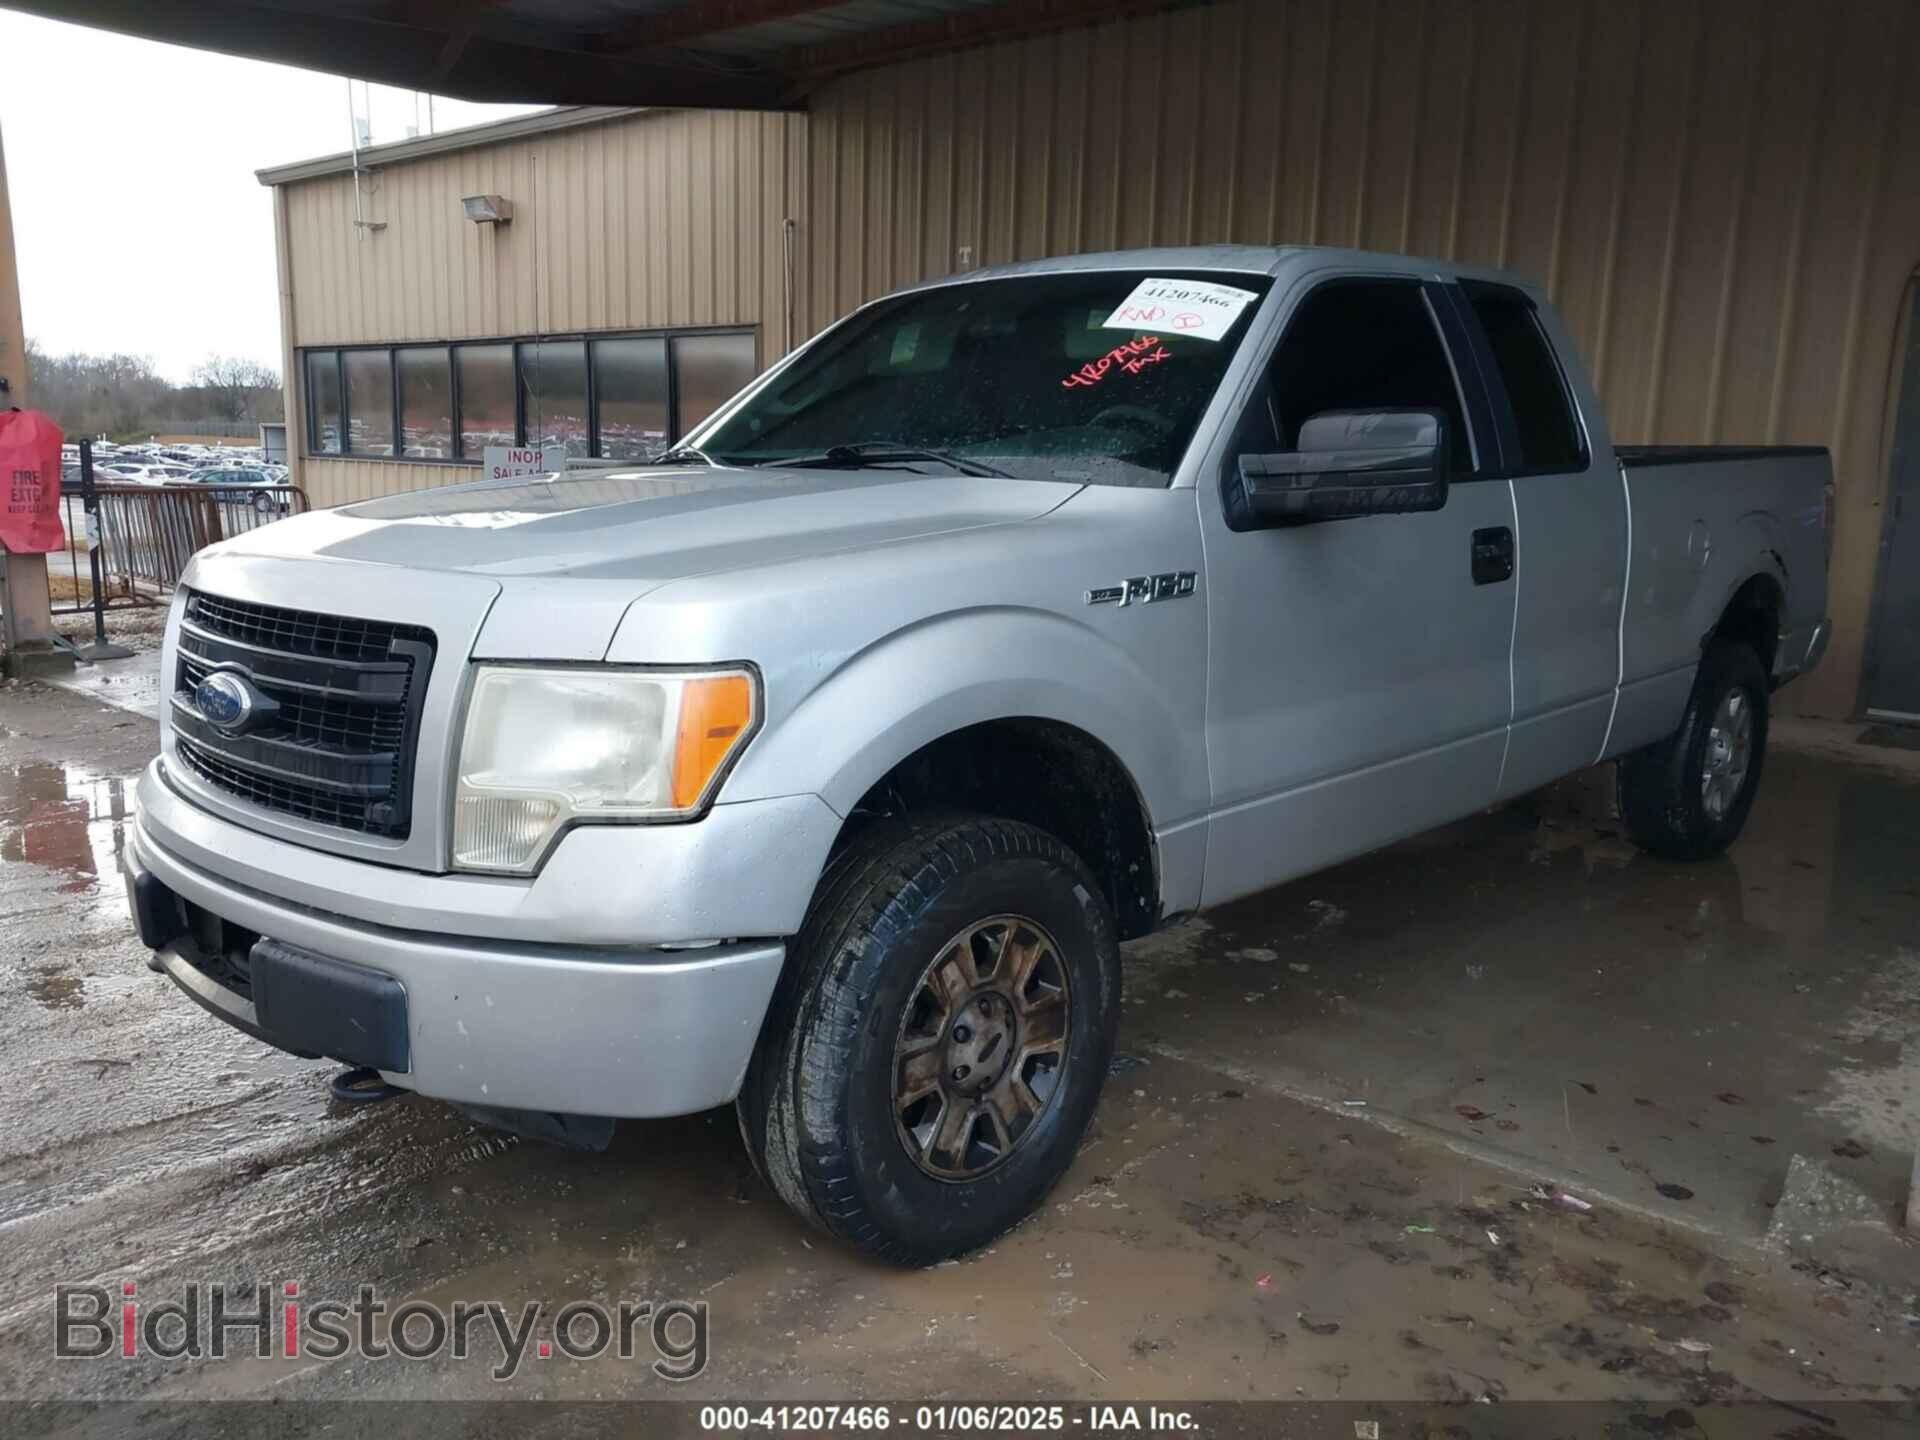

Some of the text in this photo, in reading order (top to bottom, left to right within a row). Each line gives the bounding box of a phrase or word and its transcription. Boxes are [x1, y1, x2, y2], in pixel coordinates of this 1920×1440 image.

[1144, 287, 1231, 309] 41207466
[508, 450, 543, 464] INOP
[12, 470, 40, 485] FIRE
